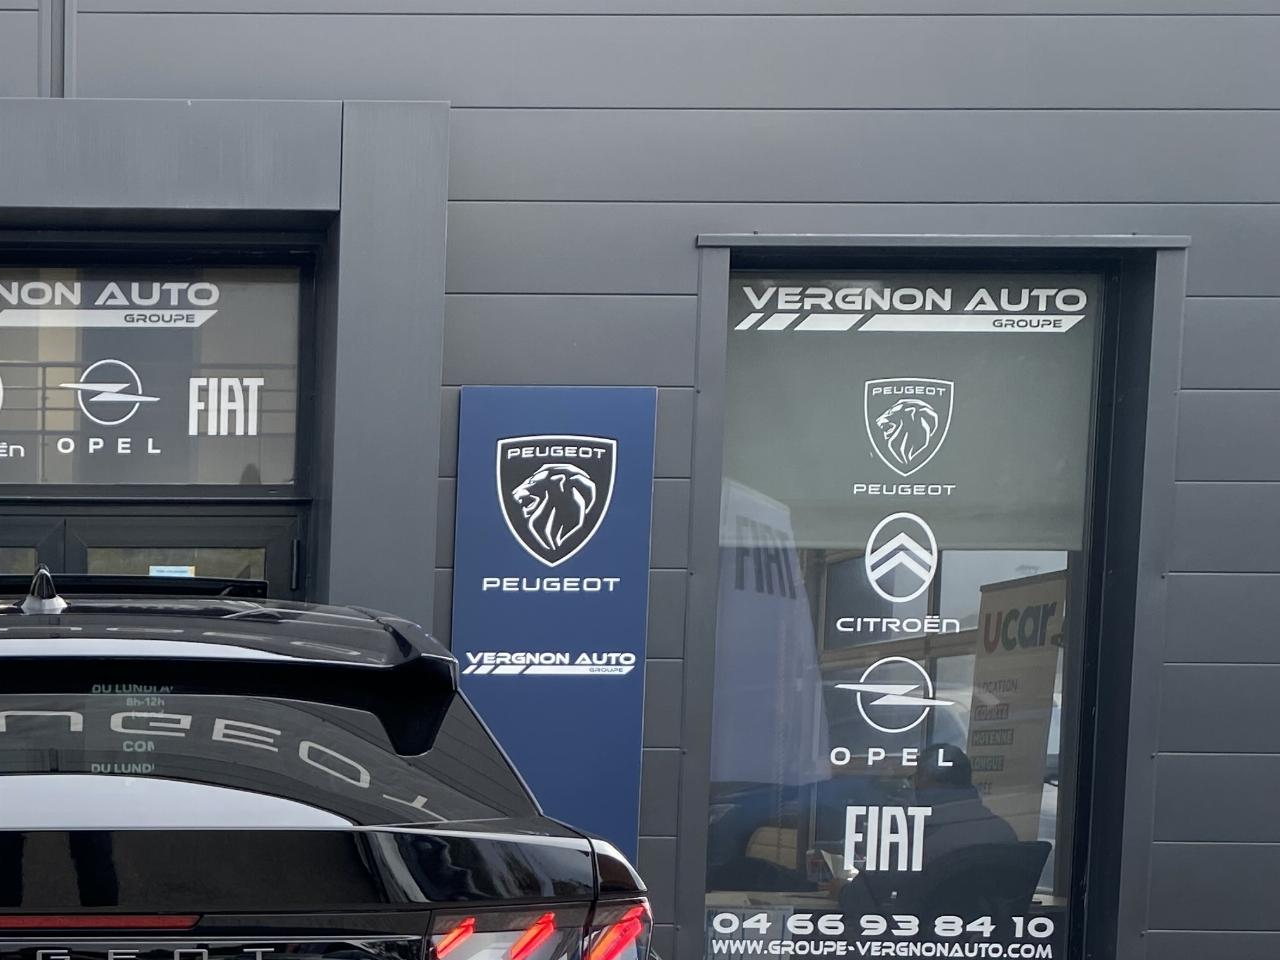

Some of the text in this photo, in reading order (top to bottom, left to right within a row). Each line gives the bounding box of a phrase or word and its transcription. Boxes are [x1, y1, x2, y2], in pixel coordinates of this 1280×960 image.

[94, 281, 221, 307] AUTO
[742, 286, 1087, 312] VERGNON AUTO
[123, 313, 197, 324] GROUPE
[991, 318, 1063, 329] GROUPE
[871, 385, 946, 396] PEUGEOT
[188, 377, 265, 436] FIAT
[56, 437, 161, 455] OPEL
[507, 446, 607, 459] PEUGEOT
[853, 484, 956, 496] PEUGEOT
[482, 577, 621, 592] PEUGEOT
[835, 616, 960, 633] CITROËN
[465, 652, 636, 665] VERGNON AUTO
[829, 747, 954, 767] OPEL
[91, 763, 155, 774] DU LUND
[843, 805, 933, 872] FIAT
[712, 912, 1055, 938] 04 66 93 84 10
[711, 939, 1053, 959] WWW.GROUPE-VERGNONAUTO.COM
